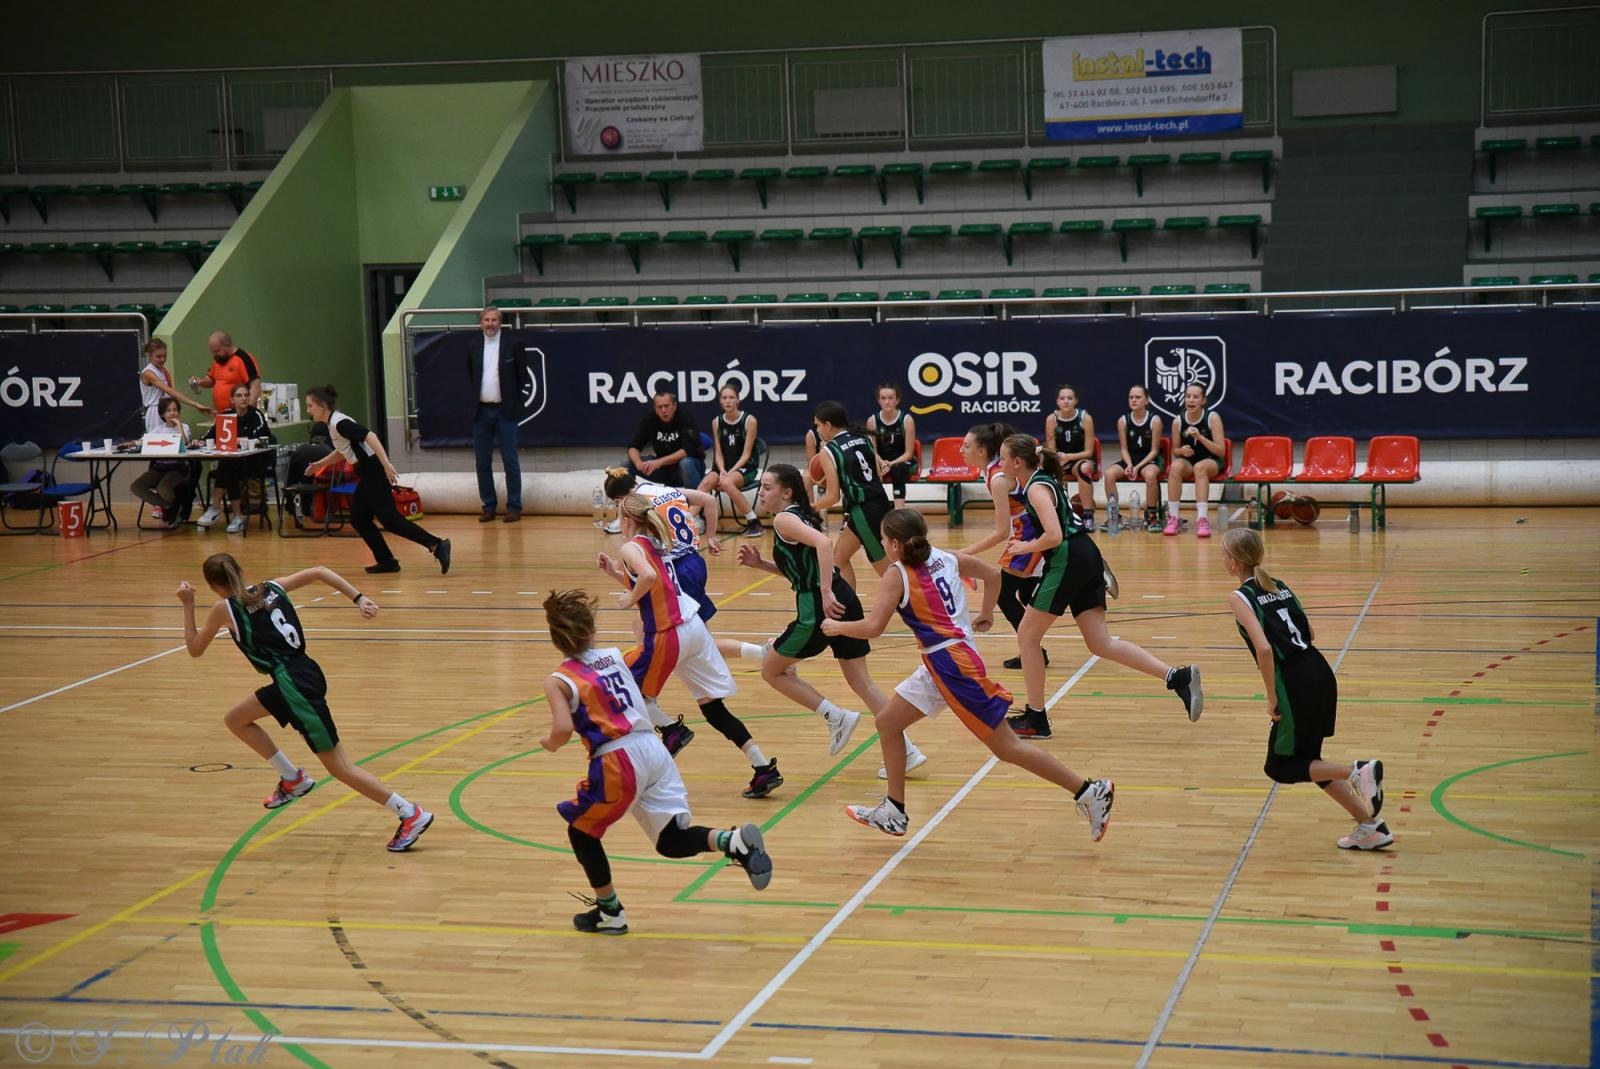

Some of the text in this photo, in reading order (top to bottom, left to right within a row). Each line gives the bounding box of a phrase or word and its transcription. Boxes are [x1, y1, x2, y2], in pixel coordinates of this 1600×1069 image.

[582, 59, 684, 83] MIESZKO
[1072, 46, 1211, 80] instal-tech
[1059, 100, 1088, 110] 47-400
[1097, 119, 1189, 133] www.instal-tech.pl
[588, 358, 808, 404] RACIBÓRZ
[908, 351, 1040, 398] OSiR
[1275, 346, 1529, 396] RACIBÓRZ
[960, 397, 1041, 414] RACIBÓRZ
[218, 419, 233, 444] 5
[67, 505, 80, 530] 5
[667, 506, 694, 545] 8
[935, 576, 957, 616] 9
[271, 607, 302, 649] 6
[1276, 607, 1308, 650] 3
